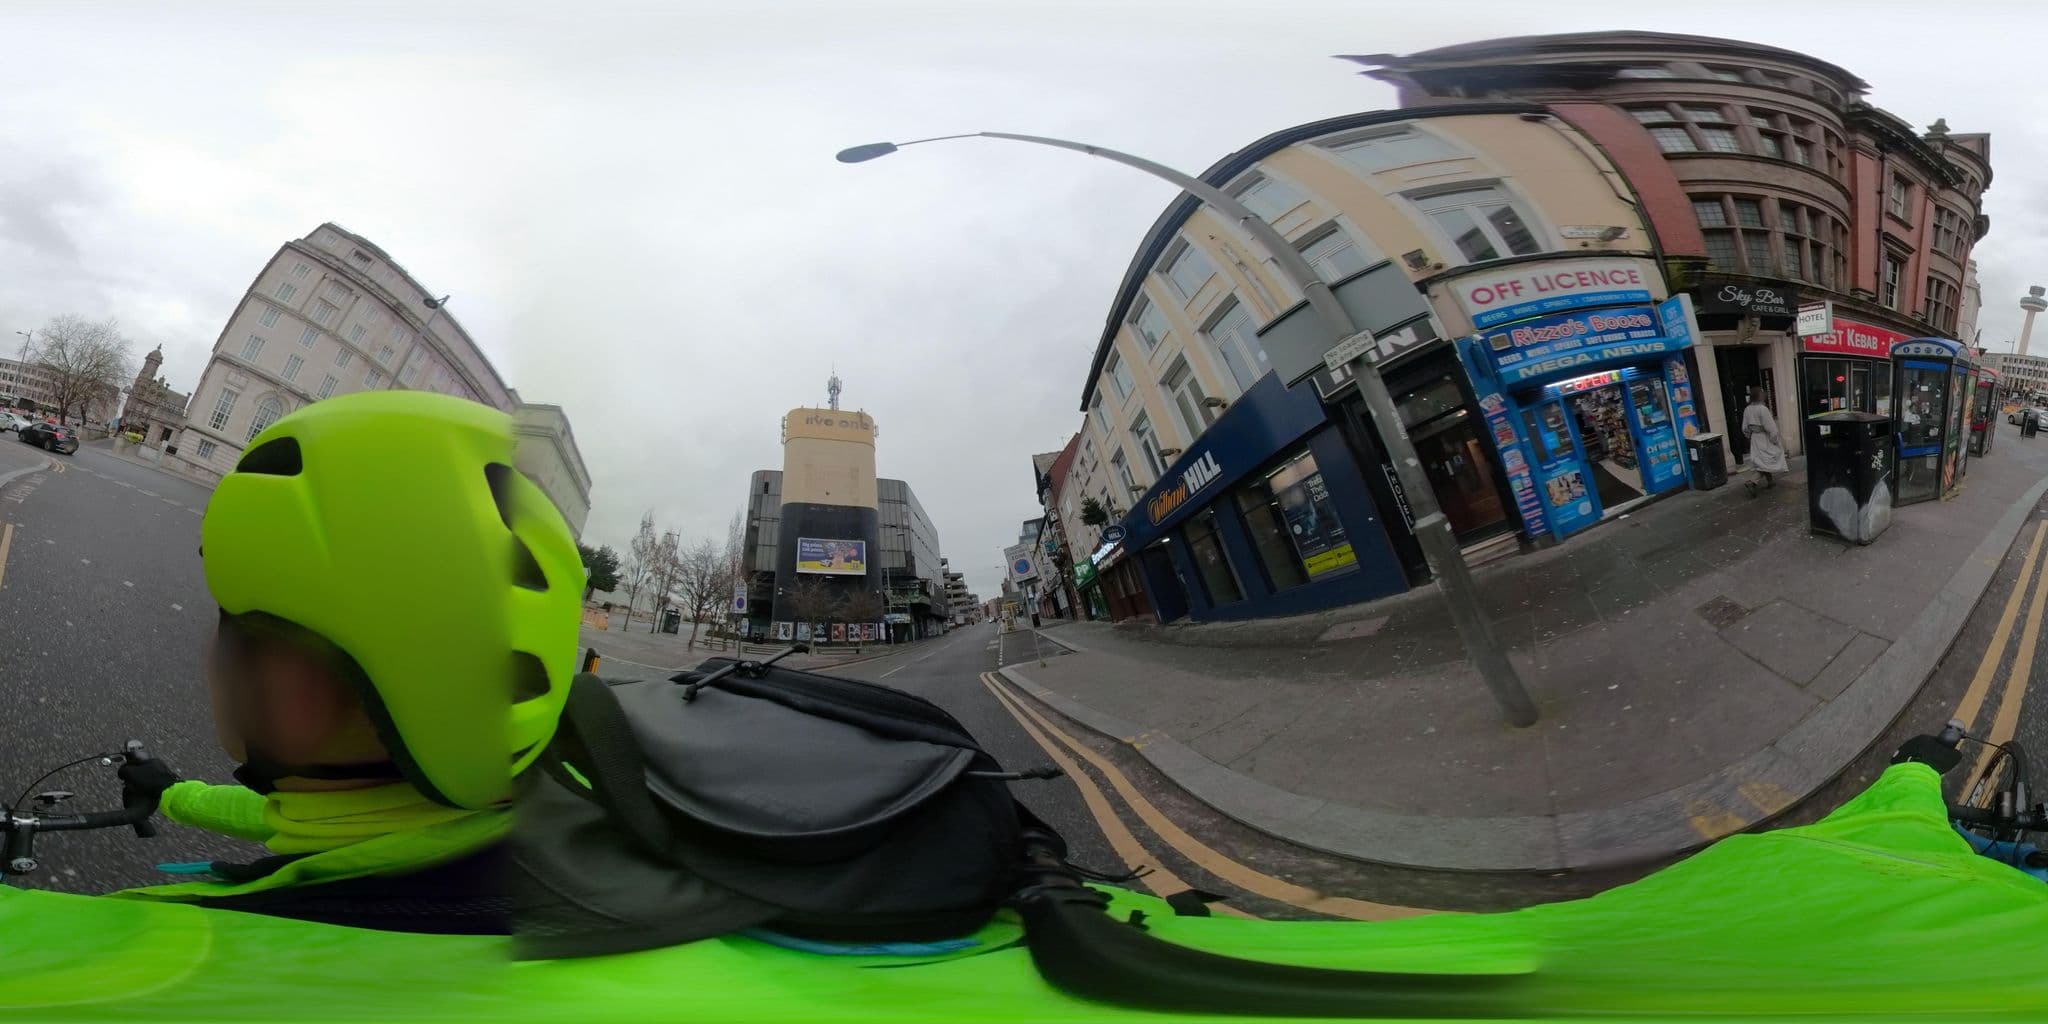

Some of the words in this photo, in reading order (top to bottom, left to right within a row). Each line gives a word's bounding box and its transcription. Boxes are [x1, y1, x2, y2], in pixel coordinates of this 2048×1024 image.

[1471, 280, 1524, 305] OFF
[1531, 269, 1641, 293] LICENCE
[1718, 285, 1752, 306] Sky
[1755, 289, 1785, 304] Bar
[1511, 318, 1587, 347] Rizzo's
[1588, 314, 1653, 332] Booze
[1799, 313, 1825, 324] HOTEL
[1846, 327, 1878, 350] KEBAB
[1518, 356, 1593, 379] MEGA
[1602, 342, 1666, 358] NEWS
[1574, 374, 1610, 390] OPEN
[1147, 475, 1188, 526] William
[1183, 449, 1222, 495] HILL
